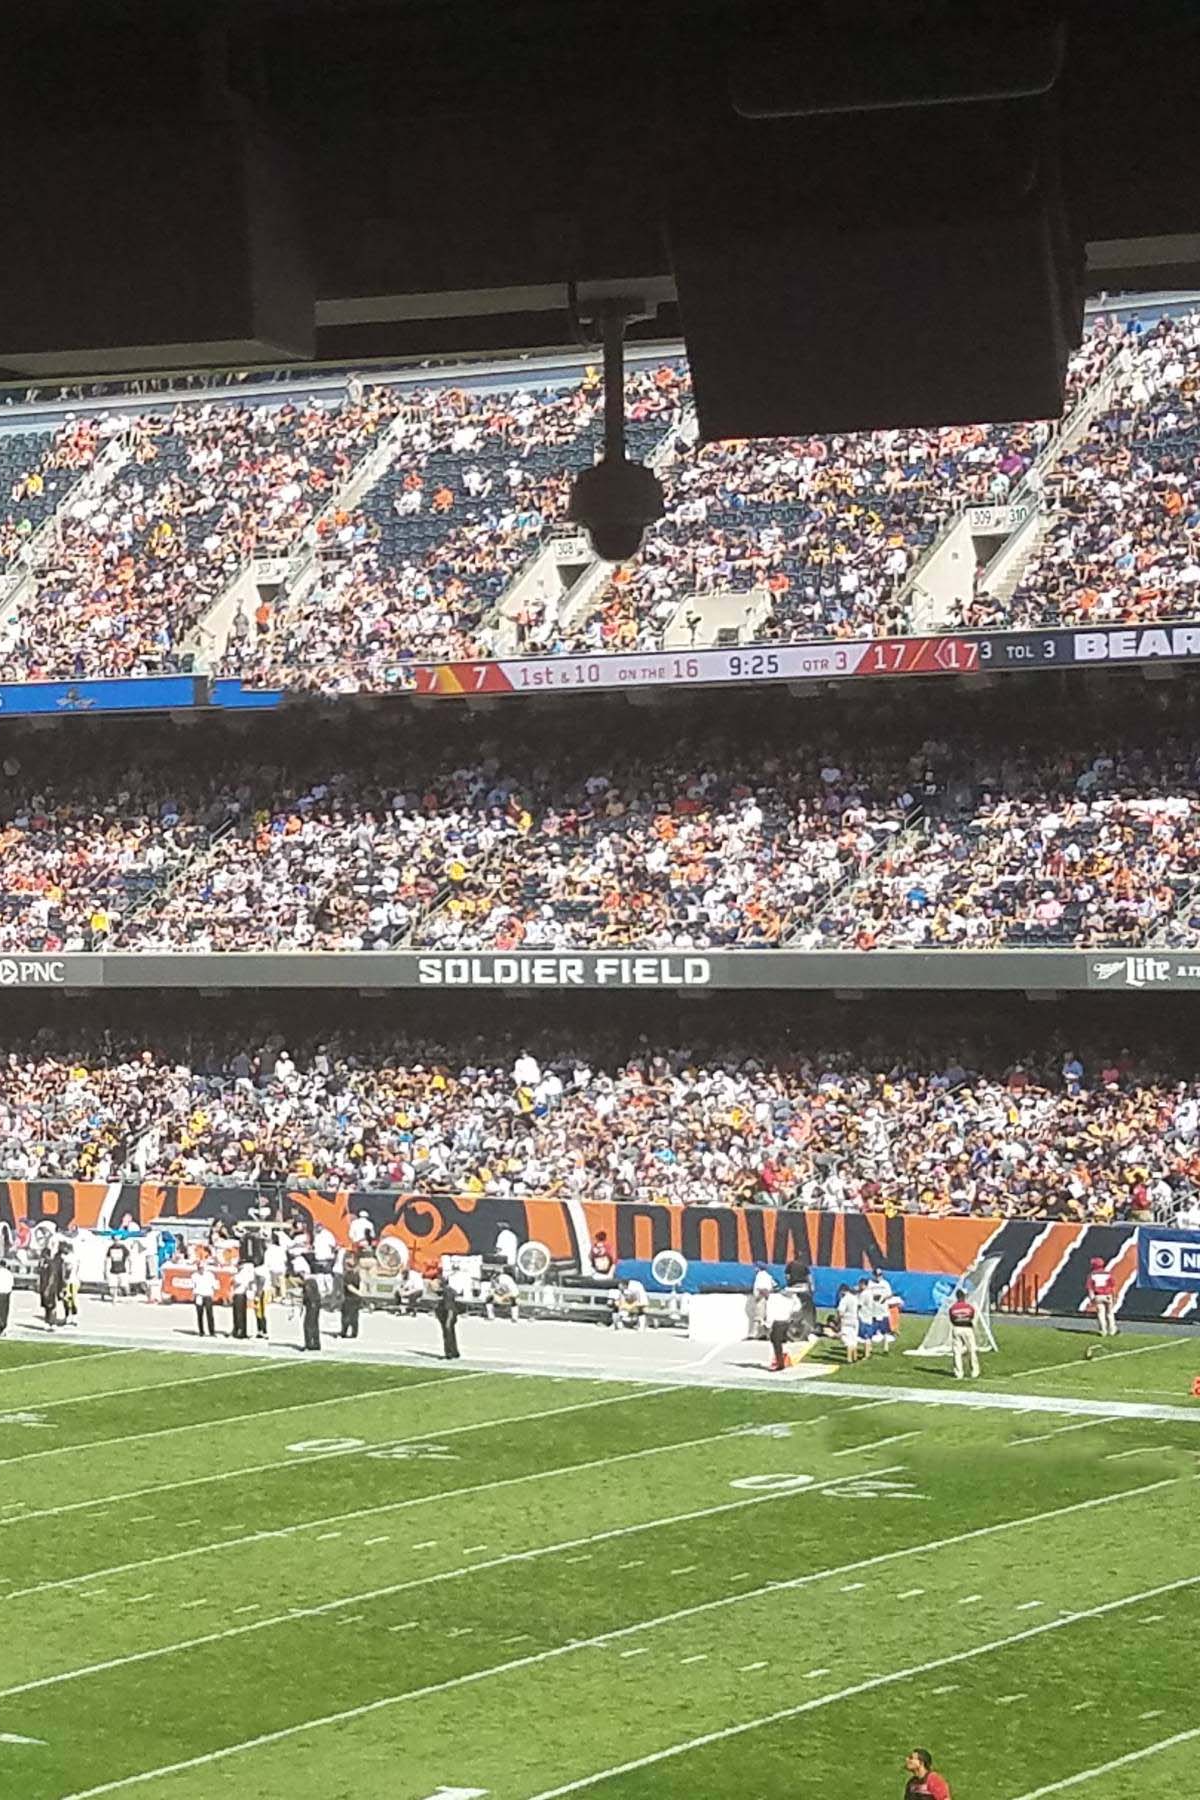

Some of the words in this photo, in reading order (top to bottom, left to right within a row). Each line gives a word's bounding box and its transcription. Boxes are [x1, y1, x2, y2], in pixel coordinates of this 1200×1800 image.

[803, 658, 829, 673] QTR
[836, 651, 848, 670] 3
[873, 644, 906, 670] 17
[946, 641, 978, 669] 17
[1006, 645, 1035, 659] TOL
[1043, 640, 1055, 658] 3
[473, 665, 488, 690] 7
[520, 666, 553, 687] 1st
[560, 671, 570, 684] &
[575, 663, 600, 684] 10
[618, 670, 636, 681] ON
[641, 667, 666, 680] THE
[673, 658, 699, 679] 16
[729, 654, 779, 676] 9:25
[20, 962, 65, 982] PNC
[417, 958, 584, 984] SOLDIER
[594, 957, 711, 984] FIELD
[617, 1204, 905, 1271] DOWN
